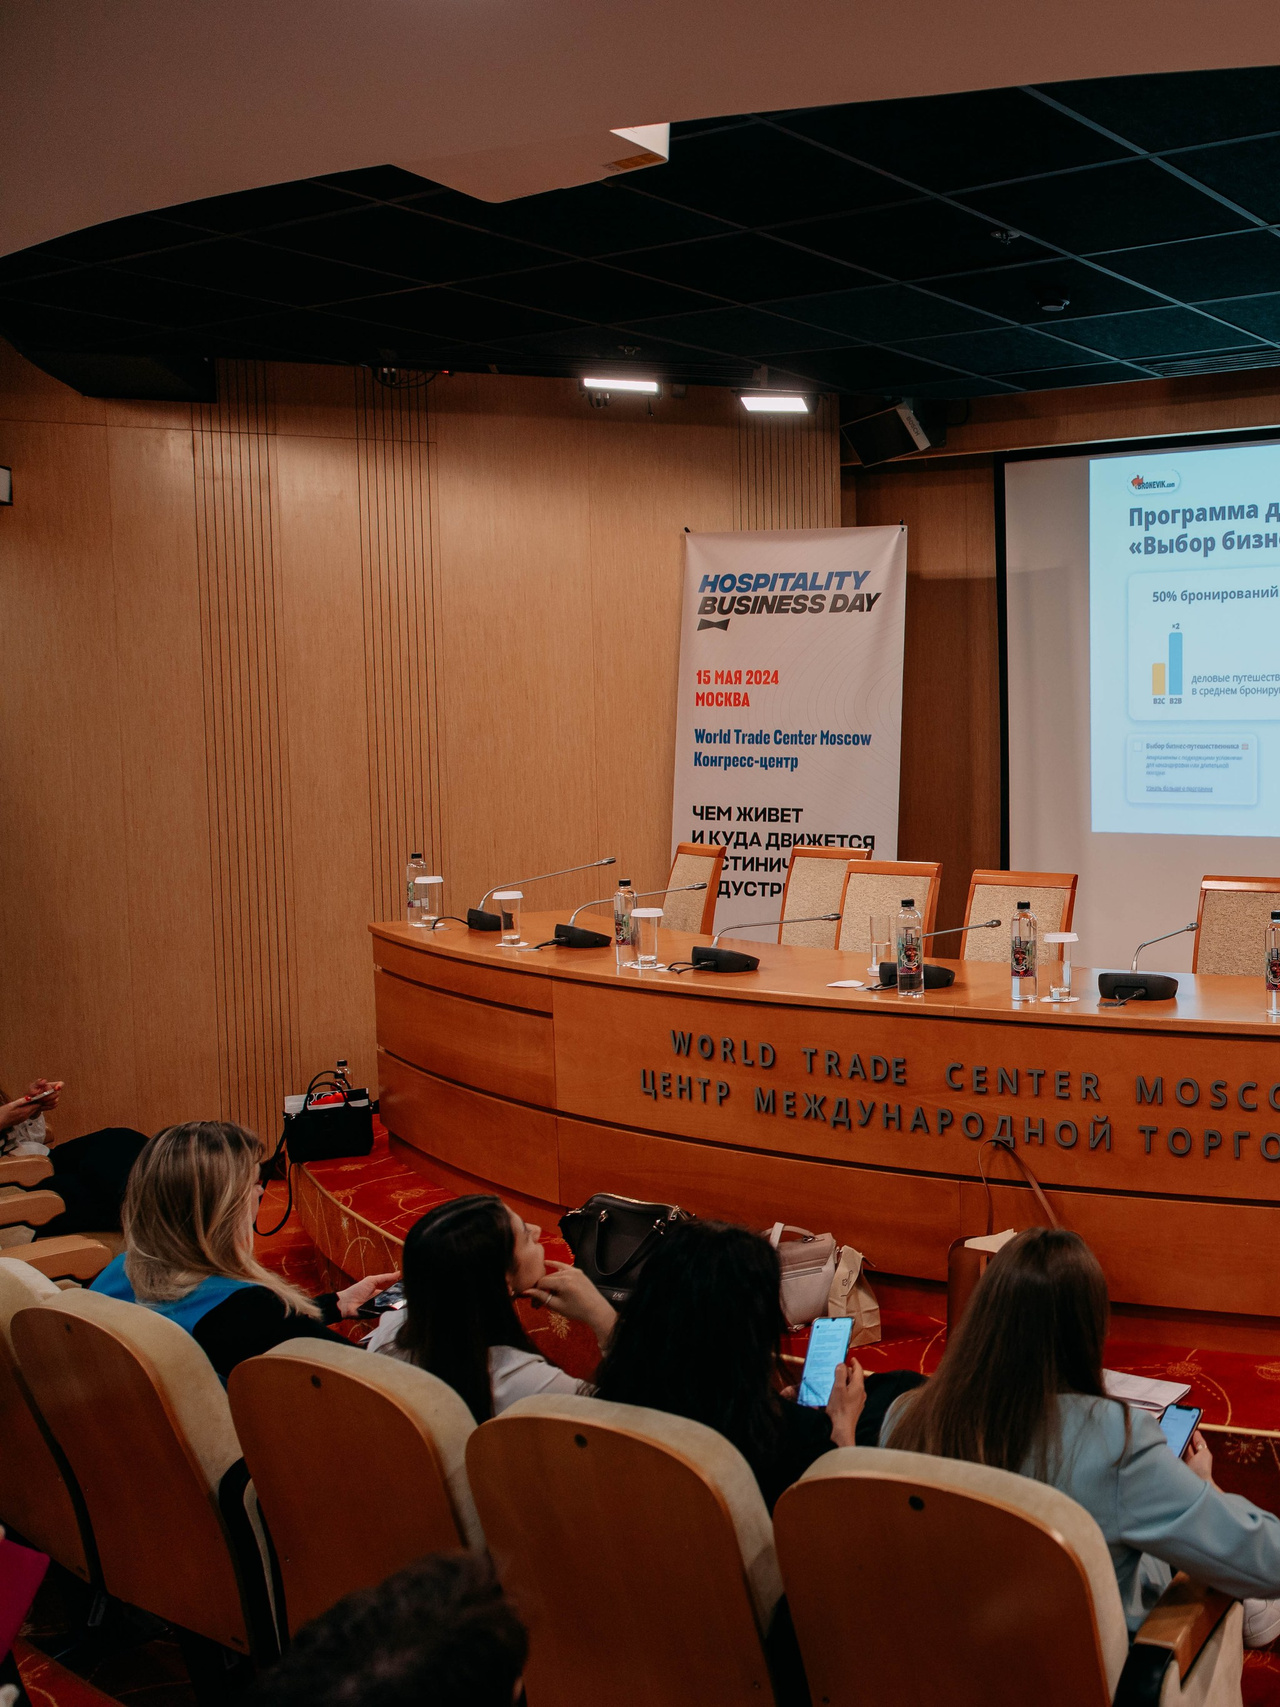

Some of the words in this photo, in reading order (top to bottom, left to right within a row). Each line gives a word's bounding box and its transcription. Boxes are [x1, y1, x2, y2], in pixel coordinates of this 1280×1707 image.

[906, 416, 920, 437] BOSCH
[1129, 503, 1259, 531] Программа
[1129, 533, 1216, 557] «Выбор
[698, 570, 871, 593] HOSPITALITY
[697, 593, 826, 615] BUSINESS
[828, 592, 882, 613] DAY
[1152, 590, 1177, 602] 50%
[1180, 585, 1279, 604] бронирований
[696, 670, 711, 685] 15
[714, 670, 742, 685] МАЯ
[745, 670, 779, 685] 2024
[1191, 674, 1230, 684] деловые
[695, 691, 750, 707] МОСКВА
[1199, 686, 1238, 697] среднем
[694, 728, 731, 744] World
[734, 729, 771, 745] Trade
[773, 729, 818, 745] Center
[820, 729, 872, 746] Moscow
[693, 751, 799, 772] Конгресс-центр
[692, 805, 732, 822] ЧЕМ
[736, 806, 803, 823] ЖИВЕТ
[691, 829, 704, 845] И
[708, 830, 762, 849] КУДА
[765, 831, 875, 850] ДВИЖЕТСЯ
[721, 855, 789, 873] СТИНИЧ
[717, 880, 786, 899] ДУСТР
[670, 1029, 776, 1068] WORLD
[801, 1047, 906, 1084] TRADE
[945, 1062, 1100, 1100] CENTER
[640, 1068, 730, 1106] ЦЕНТР
[754, 1086, 1111, 1150] МЕЖДУНАРОДНОЙ
